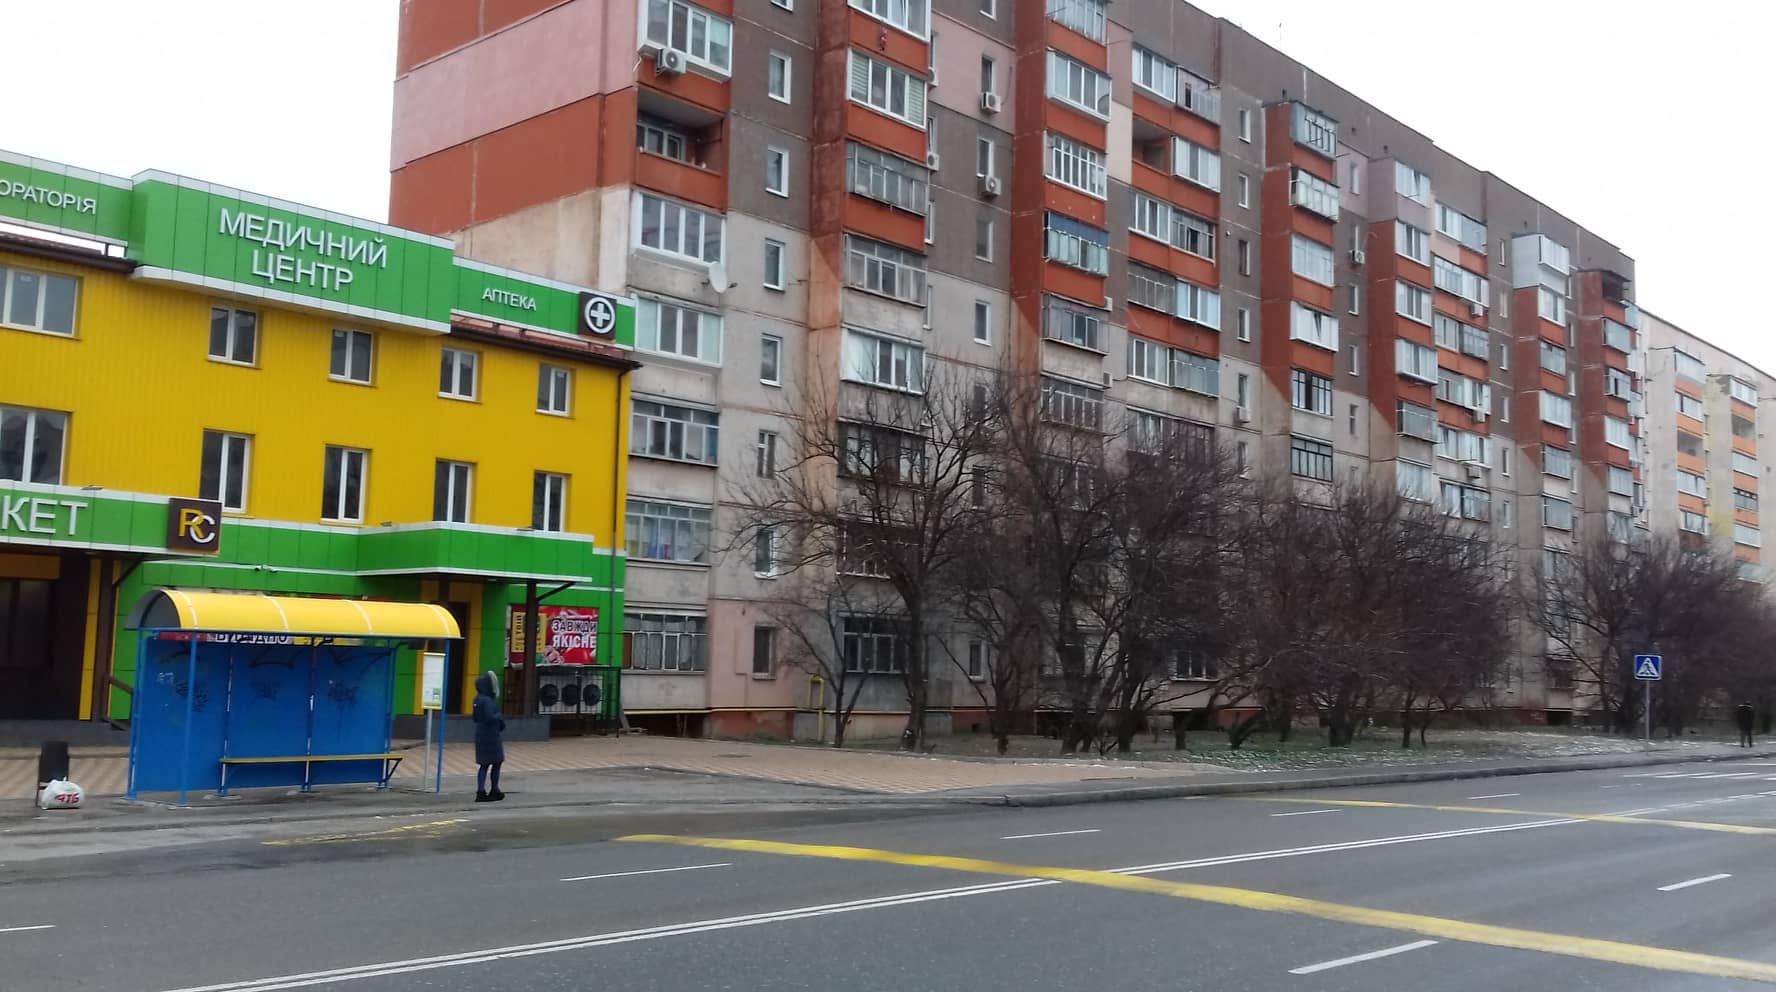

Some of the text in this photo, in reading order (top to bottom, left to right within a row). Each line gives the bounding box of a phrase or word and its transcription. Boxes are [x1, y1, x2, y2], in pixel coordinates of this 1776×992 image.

[0, 179, 97, 215] ОРАТОРІЯ
[219, 207, 388, 269] МЕДИЧНИЙ
[252, 249, 353, 292] ЦЕНТР
[482, 287, 537, 312] АПТЕКА
[551, 619, 597, 633] ЗАВЖДИ
[551, 634, 597, 648] ЯКІСНЕ
